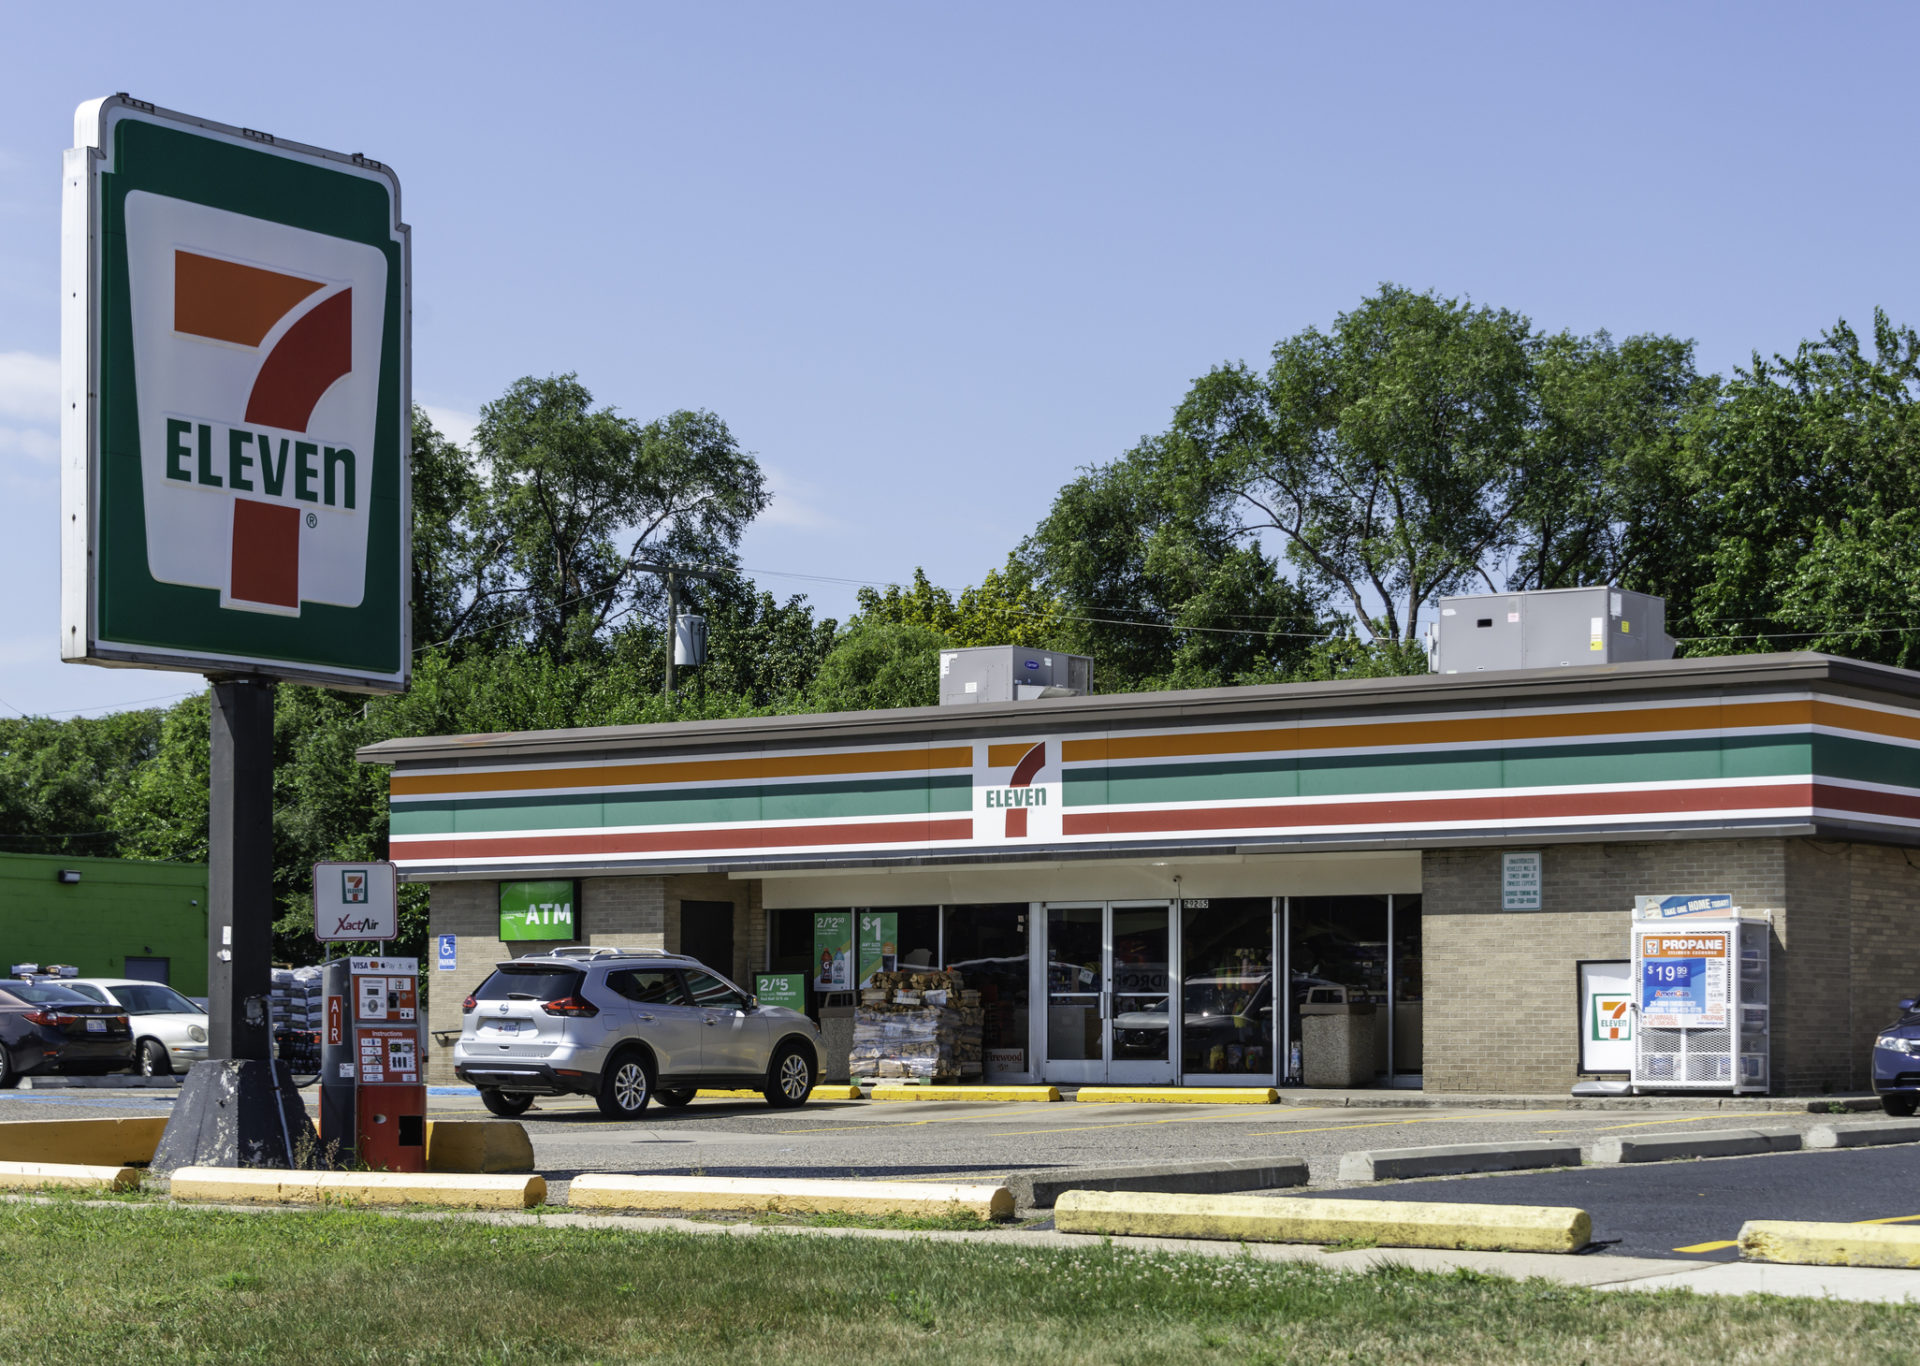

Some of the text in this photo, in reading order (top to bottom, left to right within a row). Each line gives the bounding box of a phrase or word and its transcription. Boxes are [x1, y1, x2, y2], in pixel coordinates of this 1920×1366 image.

[174, 250, 353, 608] 7
[988, 741, 1046, 838] 7
[347, 876, 363, 901] 7
[525, 903, 571, 925] ATM
[1688, 899, 1711, 912] HOME
[334, 914, 379, 935] XactAir
[862, 916, 881, 941] $1
[1662, 939, 1723, 950] PROPANE
[331, 1000, 340, 1040] AIR
[1602, 1002, 1626, 1039] 7
